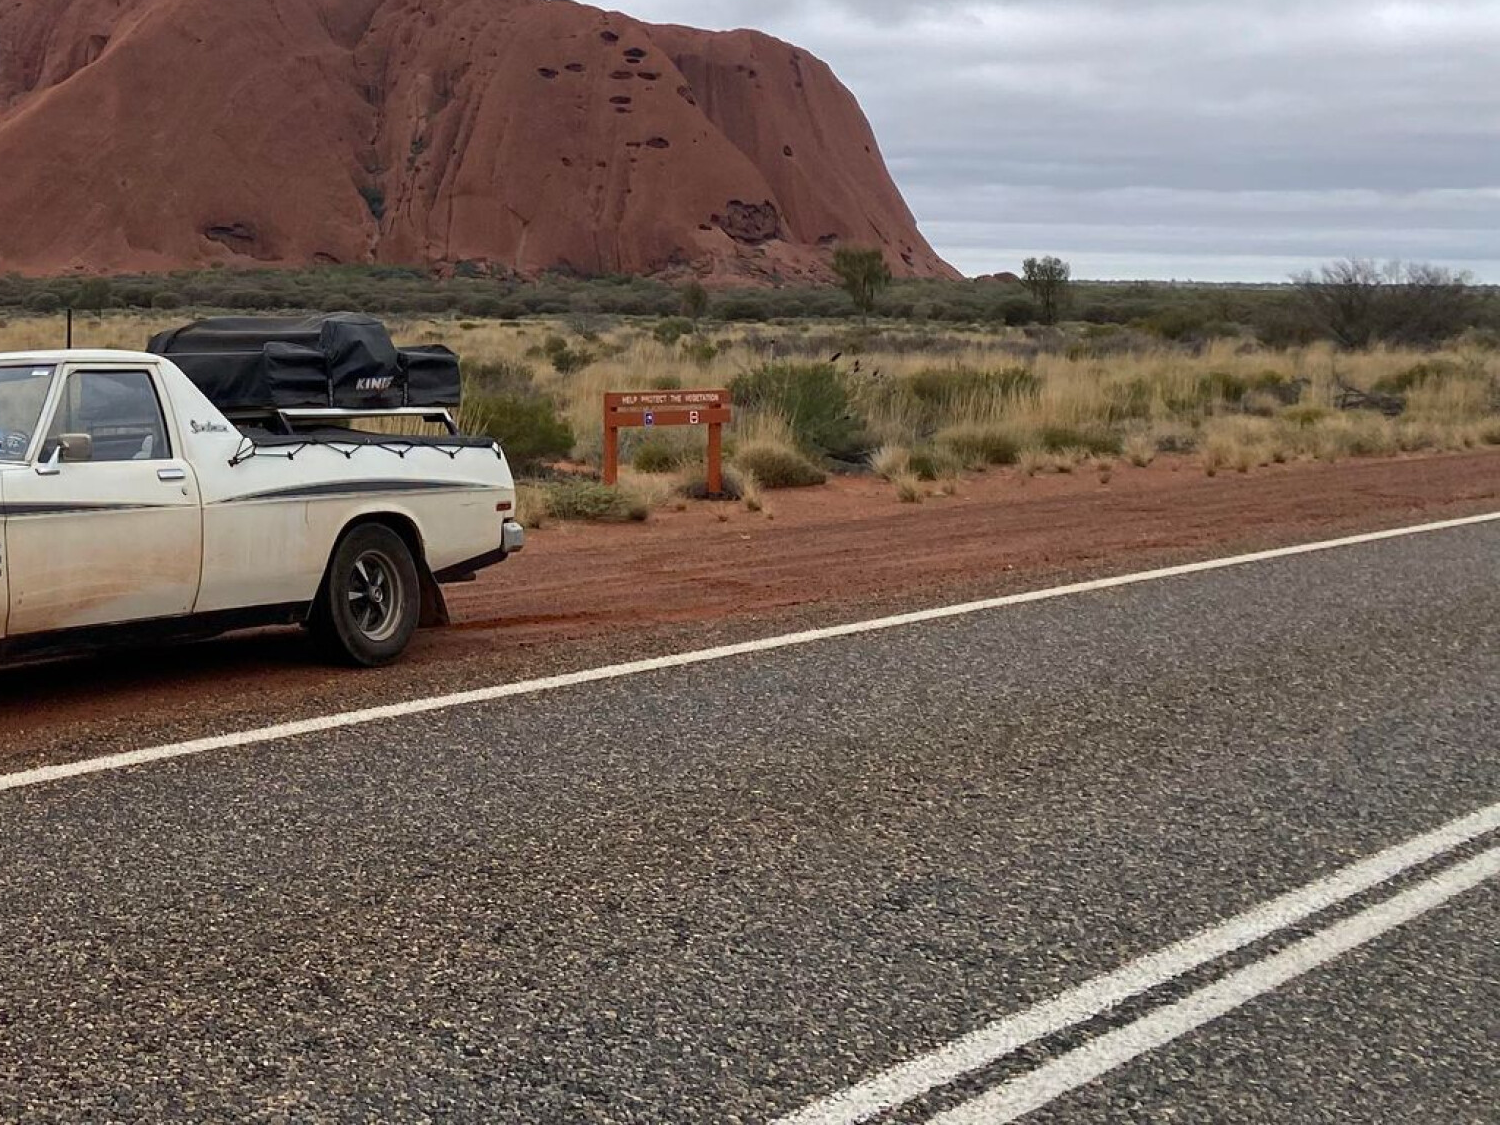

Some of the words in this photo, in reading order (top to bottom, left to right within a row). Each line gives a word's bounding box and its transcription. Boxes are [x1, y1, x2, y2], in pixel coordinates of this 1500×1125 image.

[622, 396, 638, 405] HELP
[641, 395, 667, 404] PROTECT
[670, 395, 681, 403] THE
[685, 394, 719, 403] VEGETATION
